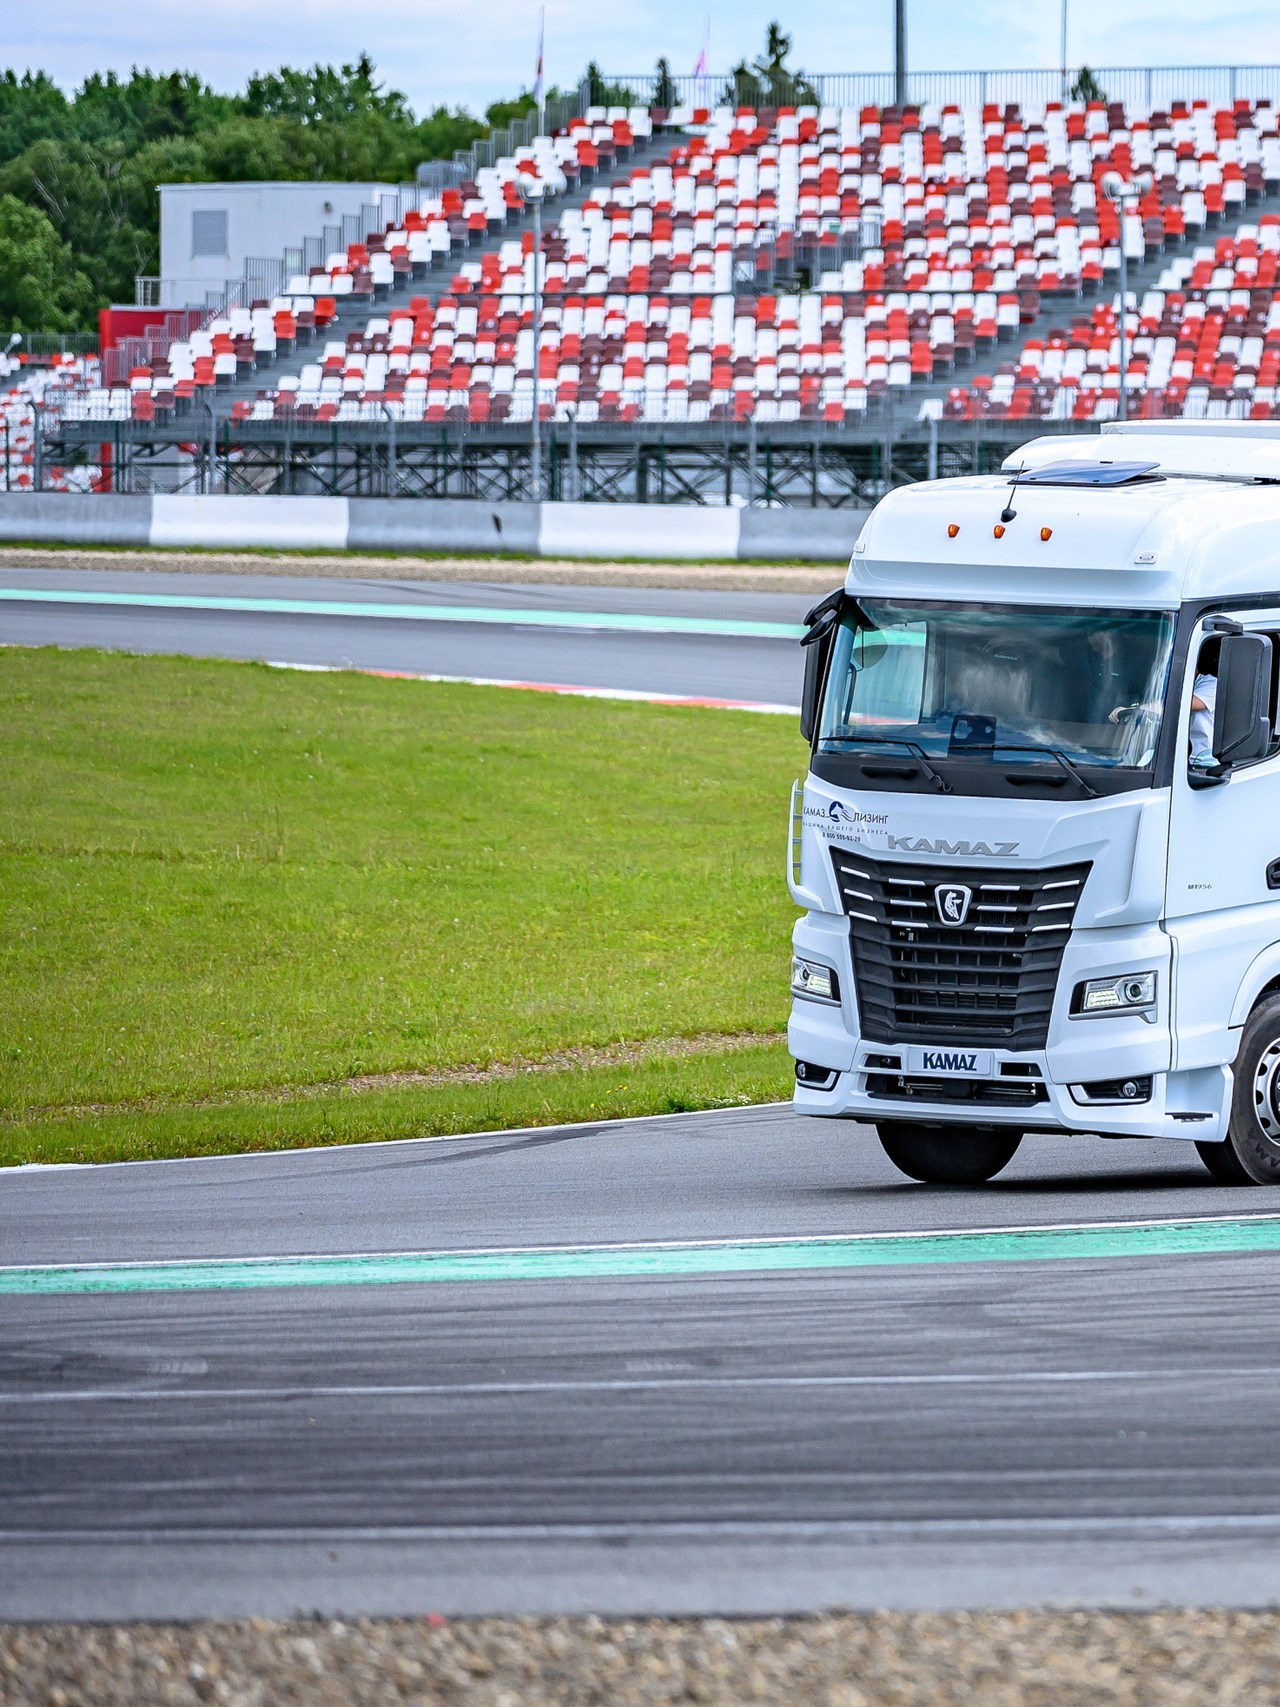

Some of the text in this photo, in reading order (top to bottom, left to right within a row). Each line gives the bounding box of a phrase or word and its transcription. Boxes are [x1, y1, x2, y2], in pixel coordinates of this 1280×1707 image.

[803, 806, 889, 824] КАМАЗ ЛИЗИНГ
[887, 835, 1020, 857] KAMAZ
[923, 1052, 977, 1071] KAMAZ
